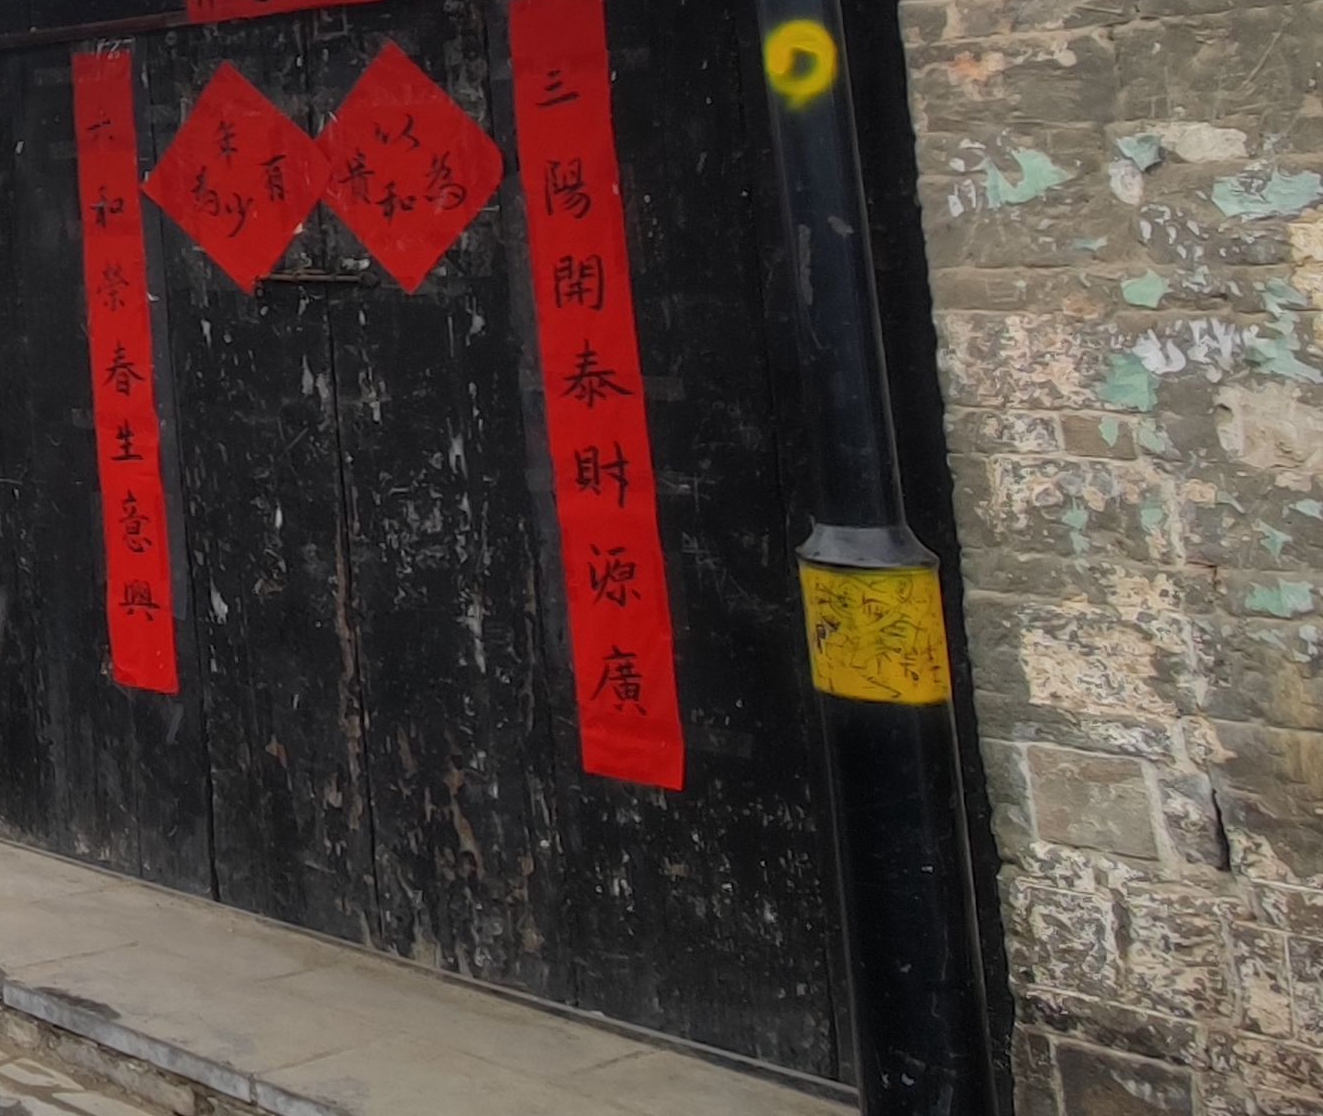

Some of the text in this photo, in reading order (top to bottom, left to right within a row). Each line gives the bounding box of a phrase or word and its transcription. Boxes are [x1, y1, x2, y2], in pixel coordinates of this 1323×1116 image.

[536, 69, 649, 716] 三陽開泰財源廣
